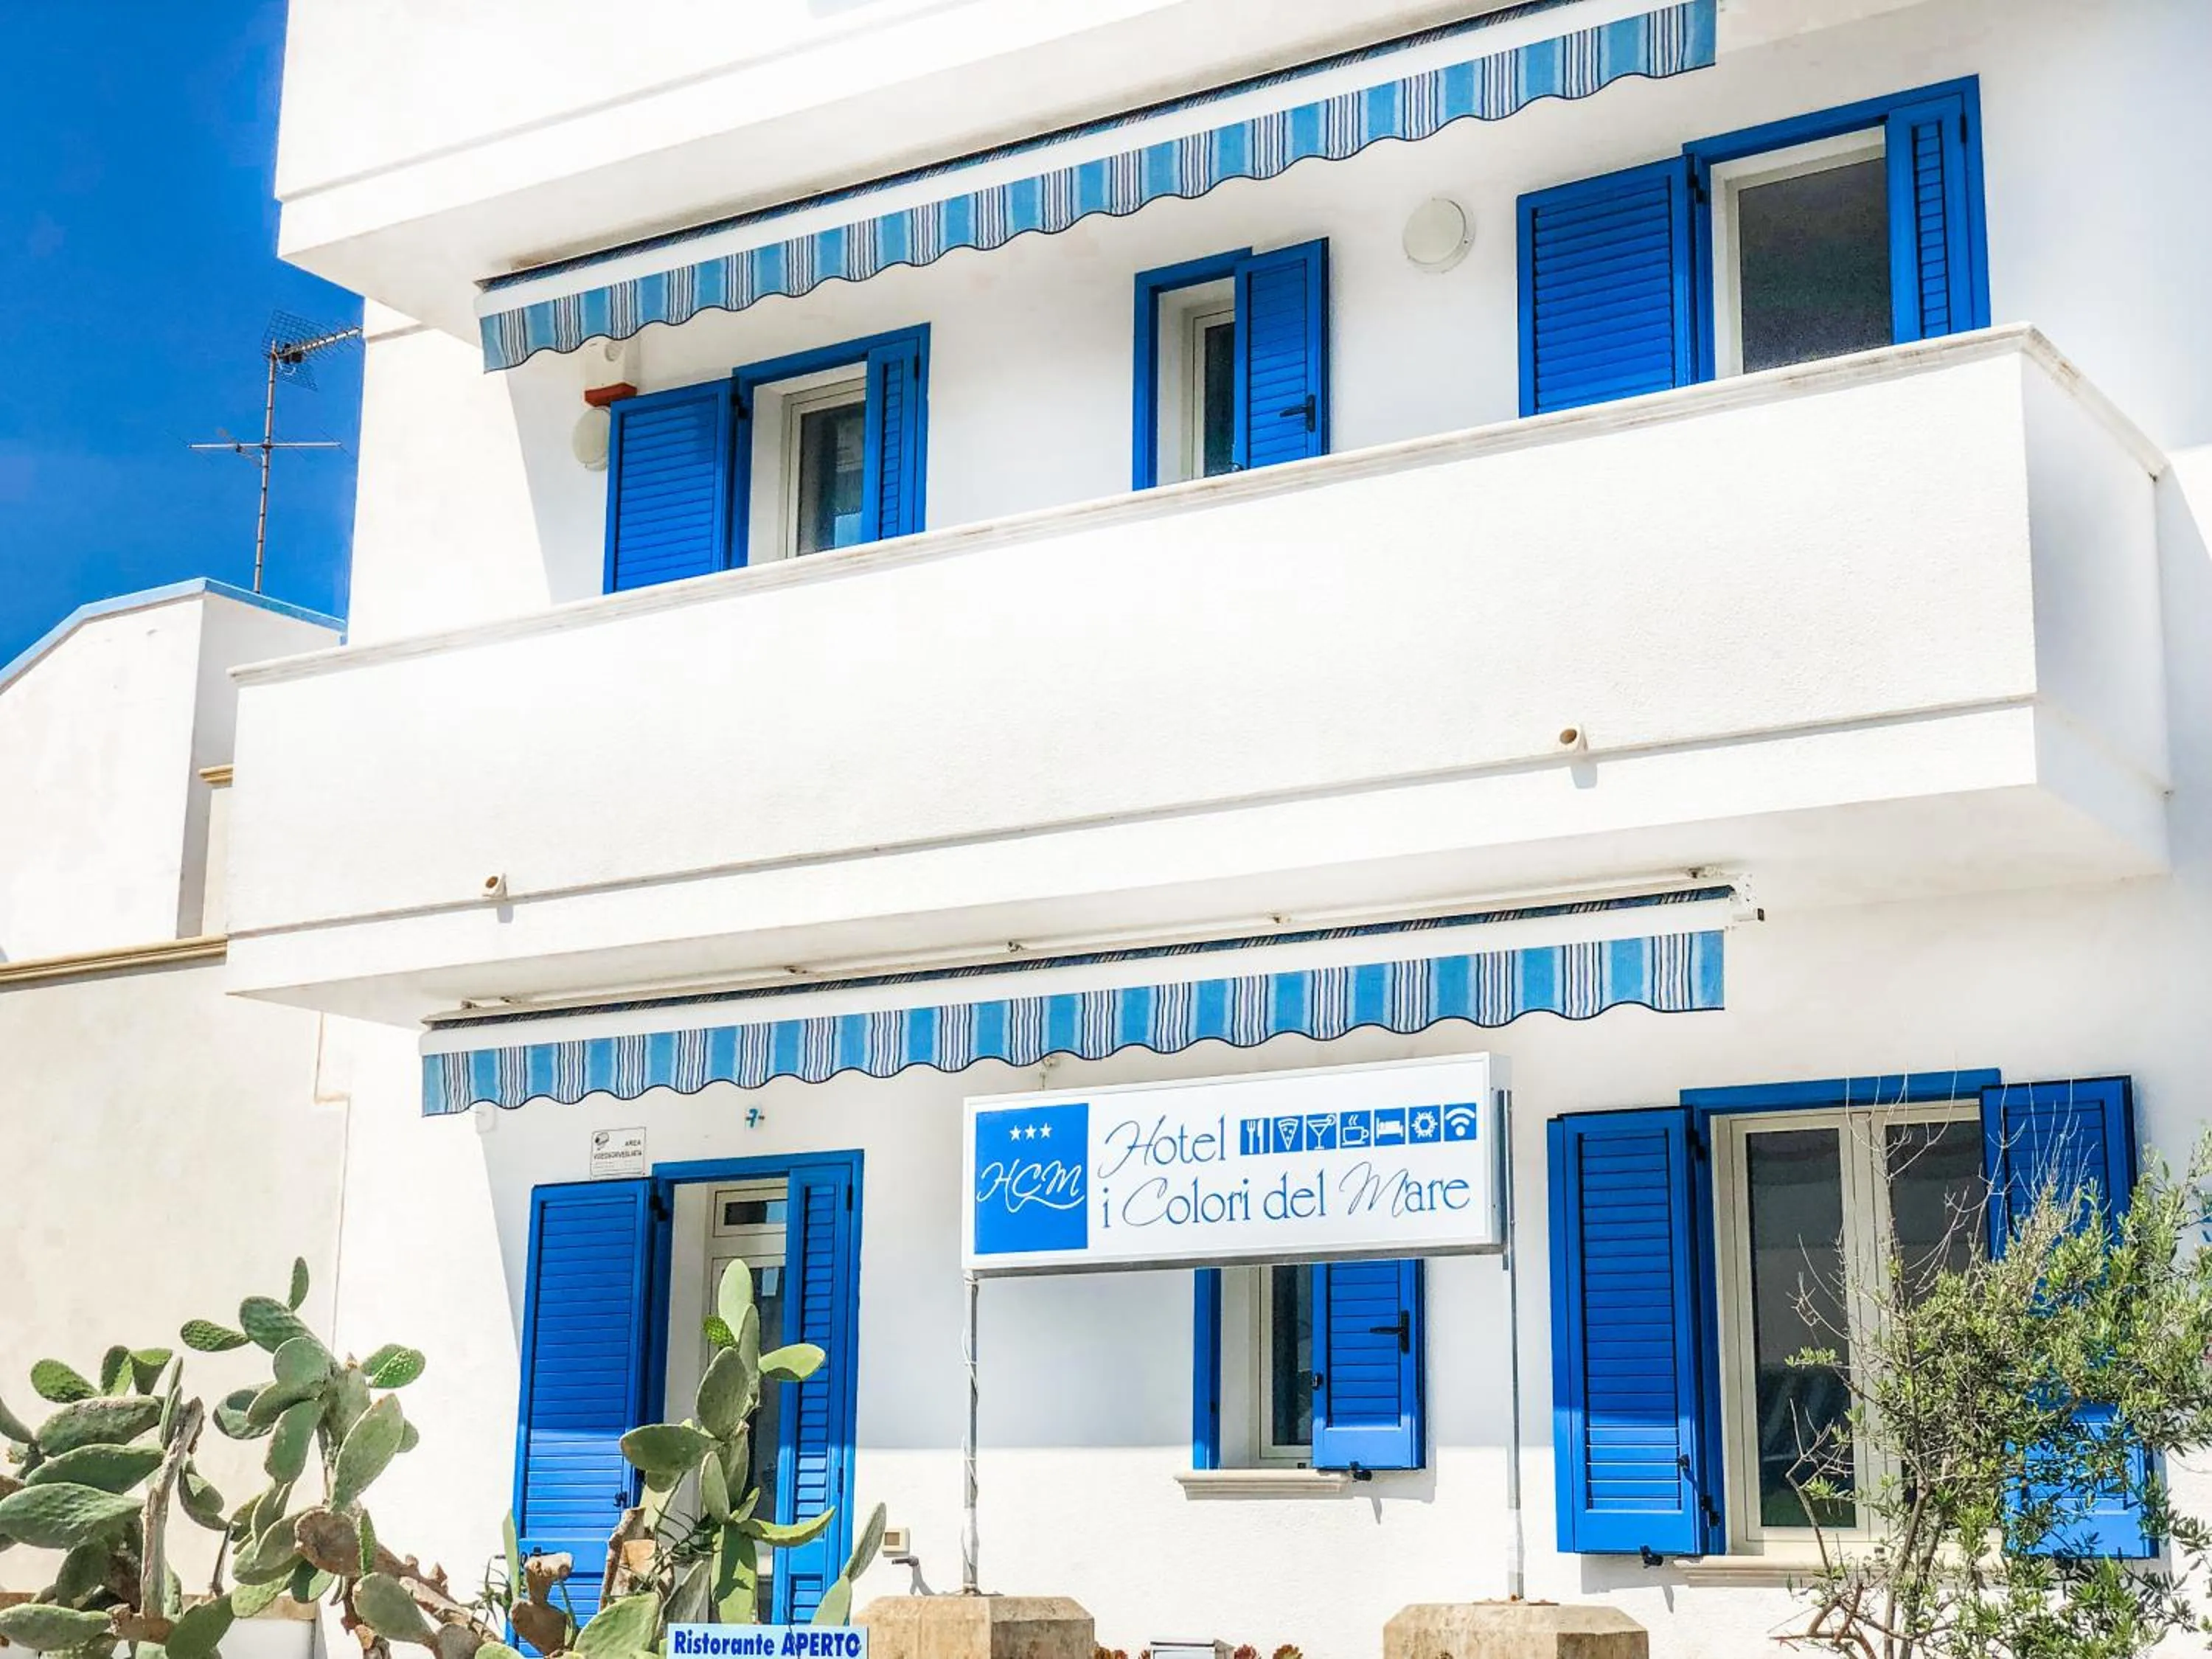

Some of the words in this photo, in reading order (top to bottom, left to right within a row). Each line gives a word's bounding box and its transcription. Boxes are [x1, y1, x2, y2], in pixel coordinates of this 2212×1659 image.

[1097, 1114, 1225, 1179] Hotel
[975, 1158, 1085, 1213] HCM
[1102, 1186, 1111, 1229] i
[1121, 1176, 1251, 1227] Colori
[1263, 1167, 1327, 1220] del
[1338, 1161, 1471, 1218] Mare
[673, 1630, 775, 1655] Ristorante
[780, 1632, 861, 1658] APERTO
